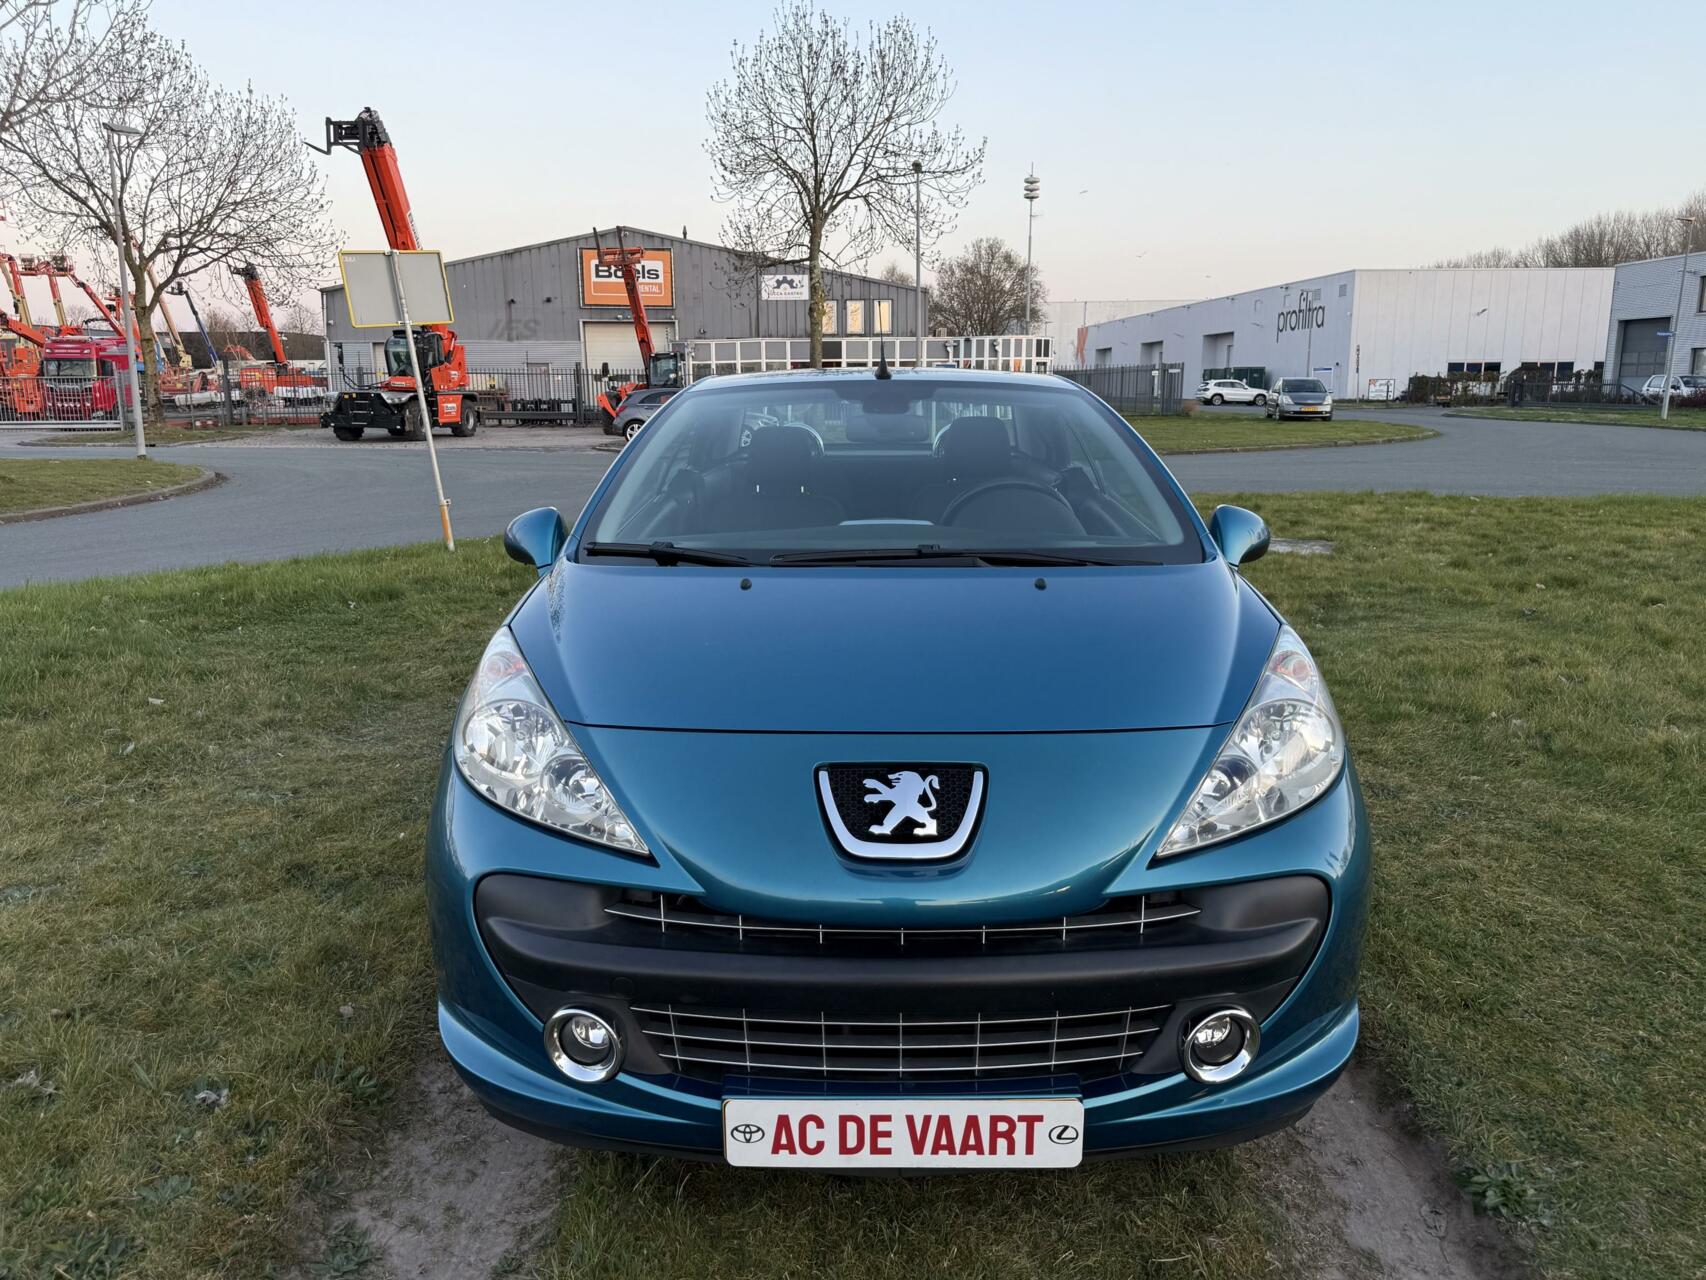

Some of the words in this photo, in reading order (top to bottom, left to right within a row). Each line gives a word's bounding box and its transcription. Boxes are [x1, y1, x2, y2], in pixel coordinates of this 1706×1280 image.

[1276, 291, 1325, 343] profiltra
[771, 1114, 825, 1156] AC
[838, 1114, 892, 1156] DE
[904, 1114, 1044, 1156] VAART
